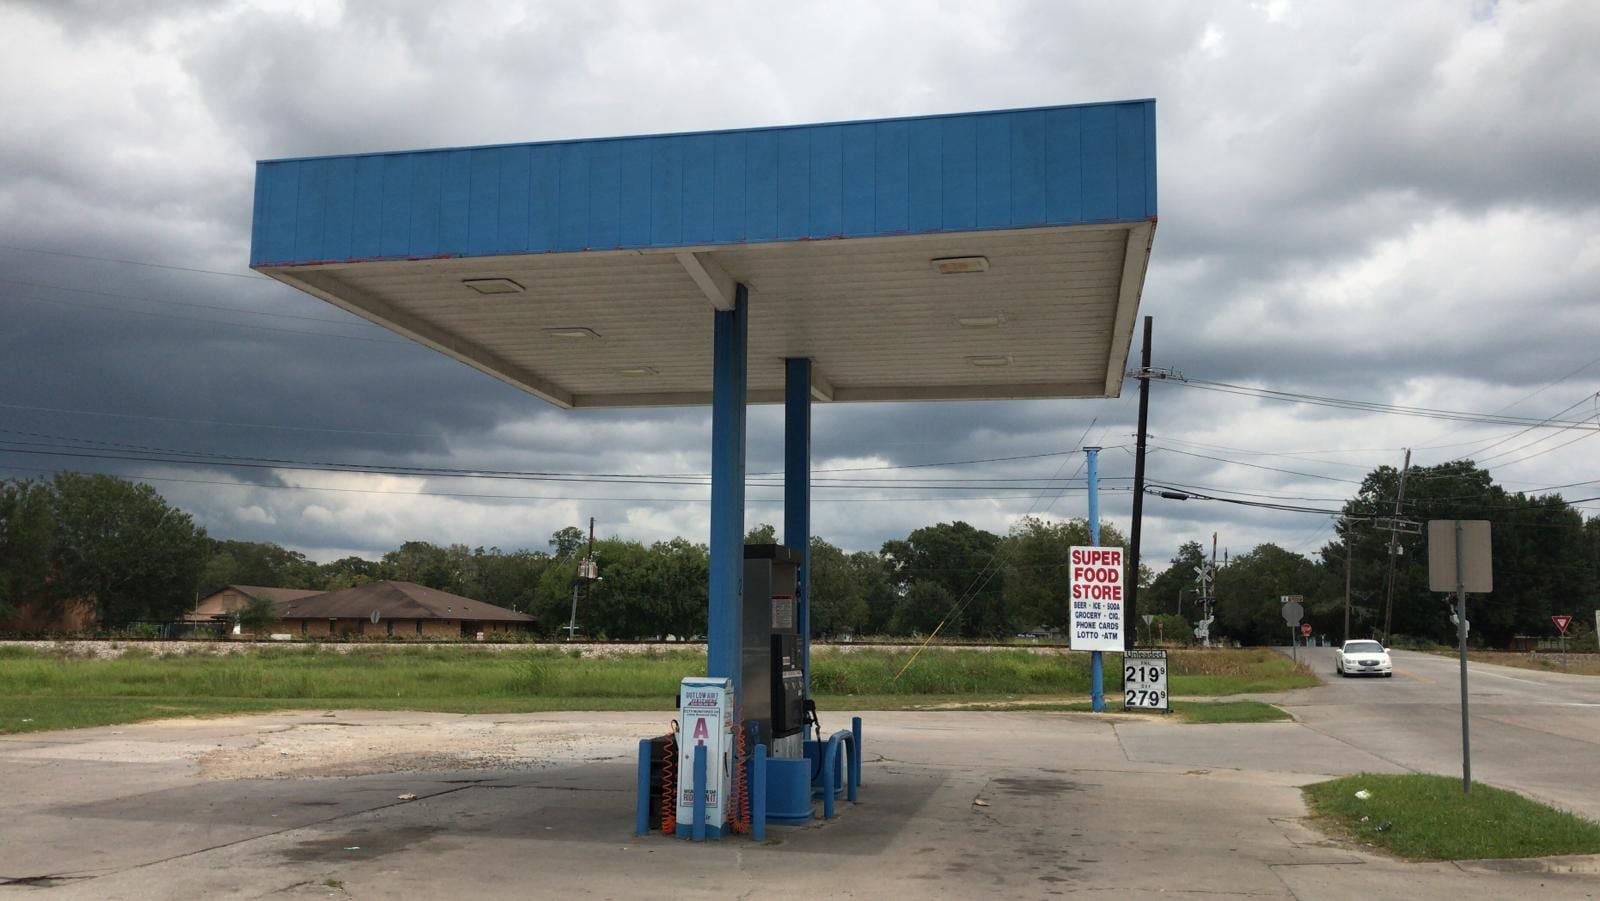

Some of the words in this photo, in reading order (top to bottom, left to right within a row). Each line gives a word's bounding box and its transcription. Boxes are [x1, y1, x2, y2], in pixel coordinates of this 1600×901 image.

[1072, 549, 1121, 566] SUPER
[1074, 567, 1119, 583] FOOD
[1073, 584, 1122, 600] STORE
[1073, 601, 1087, 609] BEER
[1092, 602, 1101, 610] ICE
[1107, 602, 1120, 611] SODA
[1075, 611, 1101, 619] GROCERY
[1076, 621, 1097, 629] PHONE
[1098, 622, 1119, 630] CARDS
[1076, 631, 1099, 639] LOTTO
[1127, 650, 1163, 658] Unleaded
